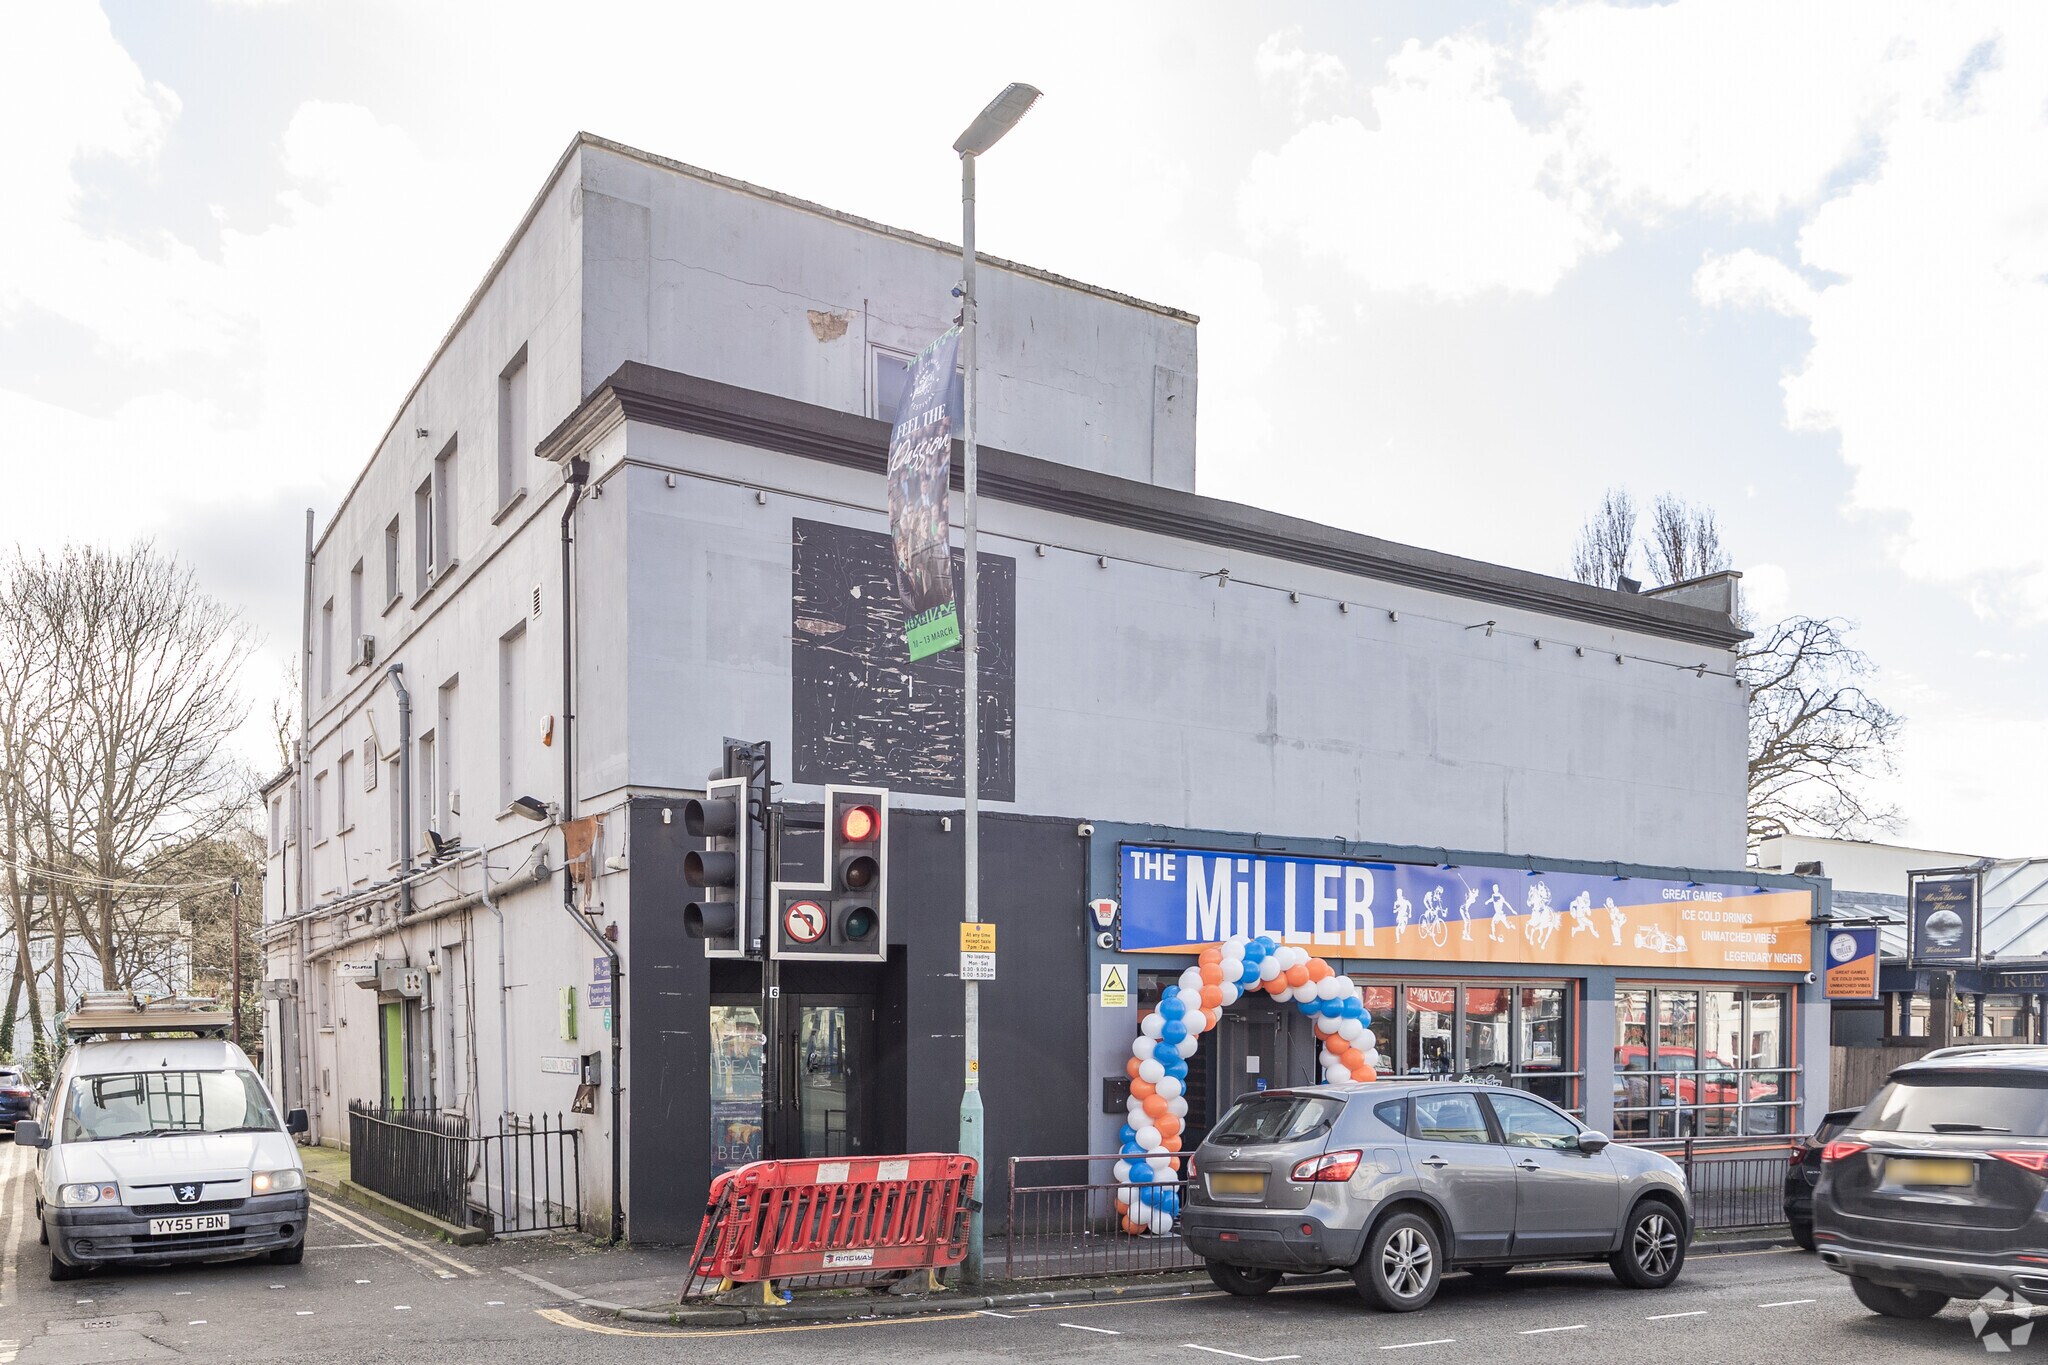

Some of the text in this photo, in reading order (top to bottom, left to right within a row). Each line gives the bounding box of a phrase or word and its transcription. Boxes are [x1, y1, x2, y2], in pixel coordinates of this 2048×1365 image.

[896, 404, 946, 440] FEEL THE
[888, 434, 950, 480] Passion
[931, 626, 953, 640] MARCH
[1130, 851, 1176, 881] THE
[1662, 888, 1723, 902] GREAT GAMES
[1938, 884, 1952, 892] The
[1922, 892, 1967, 902] Moon Under
[1682, 910, 1752, 924] ICE COLD DRINKS
[1701, 931, 1776, 944] UNMATCHED VIBES
[1725, 951, 1802, 964] LEGENDARY NIGHTS
[1992, 974, 2045, 987] FREE
[772, 988, 778, 996] 6
[156, 1216, 223, 1232] YY55 FBN
